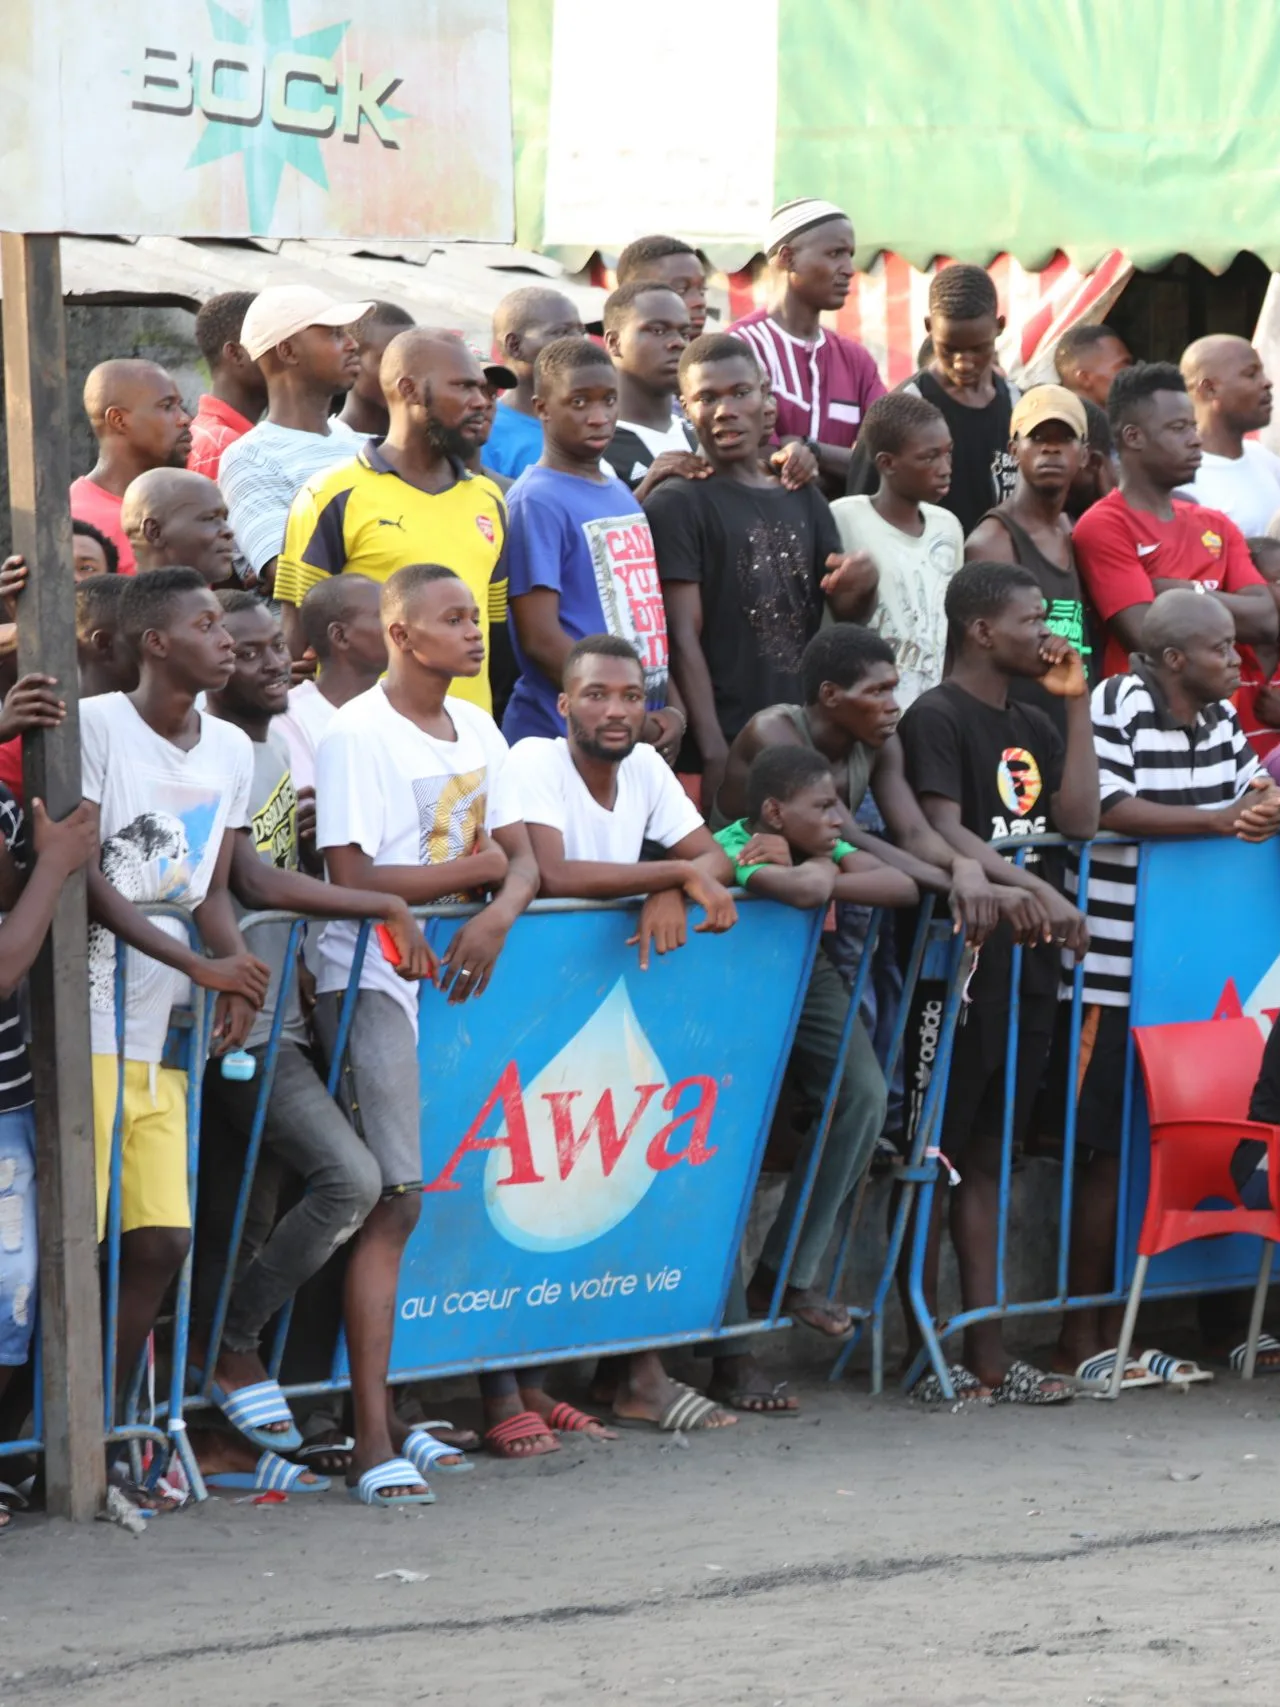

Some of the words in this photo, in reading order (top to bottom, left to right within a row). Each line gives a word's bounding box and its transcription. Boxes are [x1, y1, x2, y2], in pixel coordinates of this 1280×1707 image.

[130, 38, 404, 150] BOCK
[918, 1000, 943, 1063] adida
[422, 1059, 719, 1193] Awa
[400, 1296, 436, 1320] au
[443, 1285, 521, 1315] cœur
[526, 1277, 562, 1307] de
[570, 1271, 638, 1302] votre
[646, 1264, 683, 1292] vie
